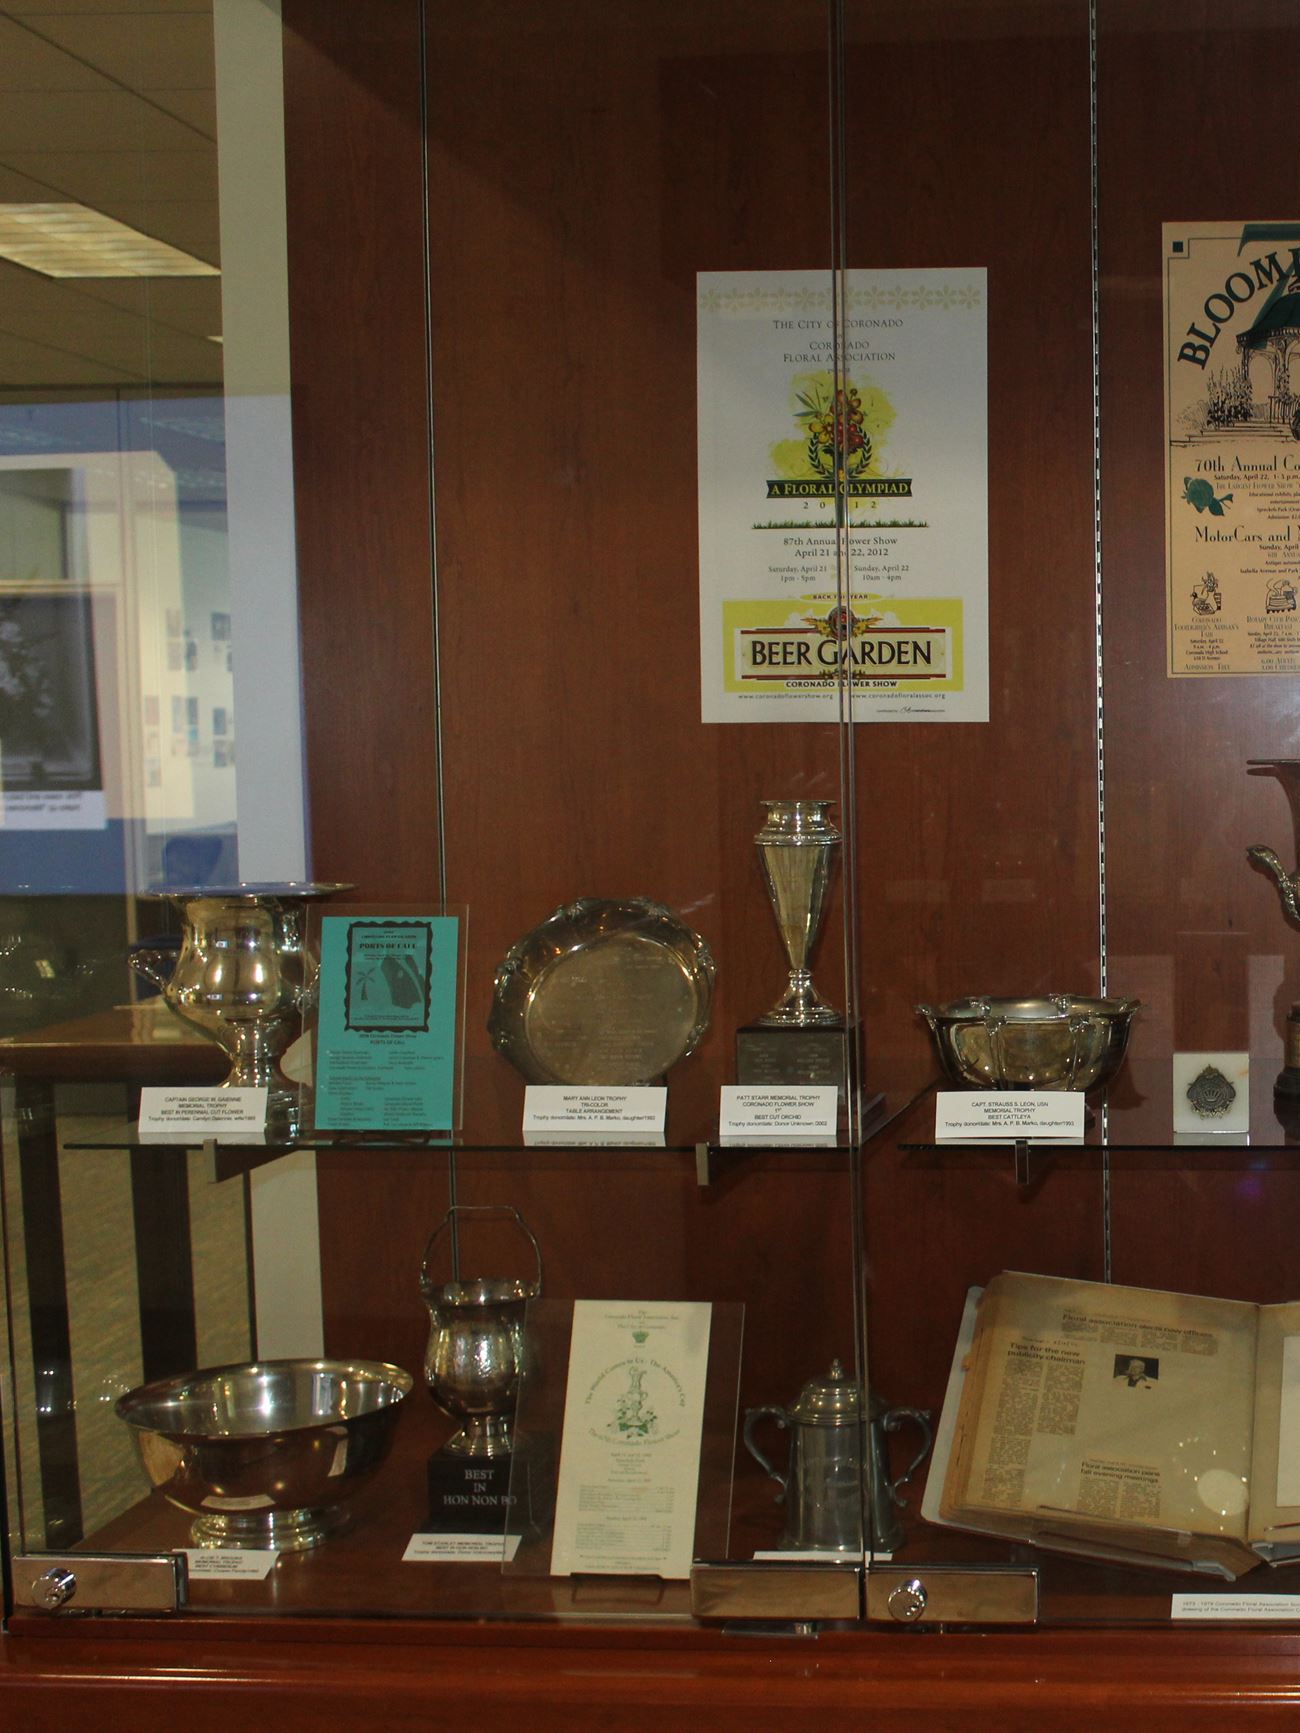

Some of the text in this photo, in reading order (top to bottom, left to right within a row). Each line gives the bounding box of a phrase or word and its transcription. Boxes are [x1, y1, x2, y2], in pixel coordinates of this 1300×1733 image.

[773, 320, 794, 329] THE
[798, 320, 822, 329] CITY
[783, 353, 822, 362] FLORAL
[1195, 456, 1224, 472] 70th
[1231, 455, 1276, 471] Annual
[1243, 473, 1257, 481] April
[771, 483, 908, 494] A FLORAL OLYMPIAD
[1195, 526, 1262, 542] MotorCars
[1268, 525, 1290, 541] and
[807, 537, 838, 545] Annua
[873, 537, 897, 545] Show
[1284, 543, 1299, 551] April
[795, 549, 817, 558] April
[852, 549, 865, 557] 22,
[769, 565, 797, 573] Saturday,
[801, 565, 817, 573] April
[855, 565, 879, 573] Sunday,
[882, 565, 899, 573] April
[752, 640, 931, 666] BEER GARDEN
[464, 1469, 494, 1480] BEST
[473, 1482, 486, 1493] IN
[443, 1495, 469, 1505] HON
[472, 1496, 498, 1506] NON
